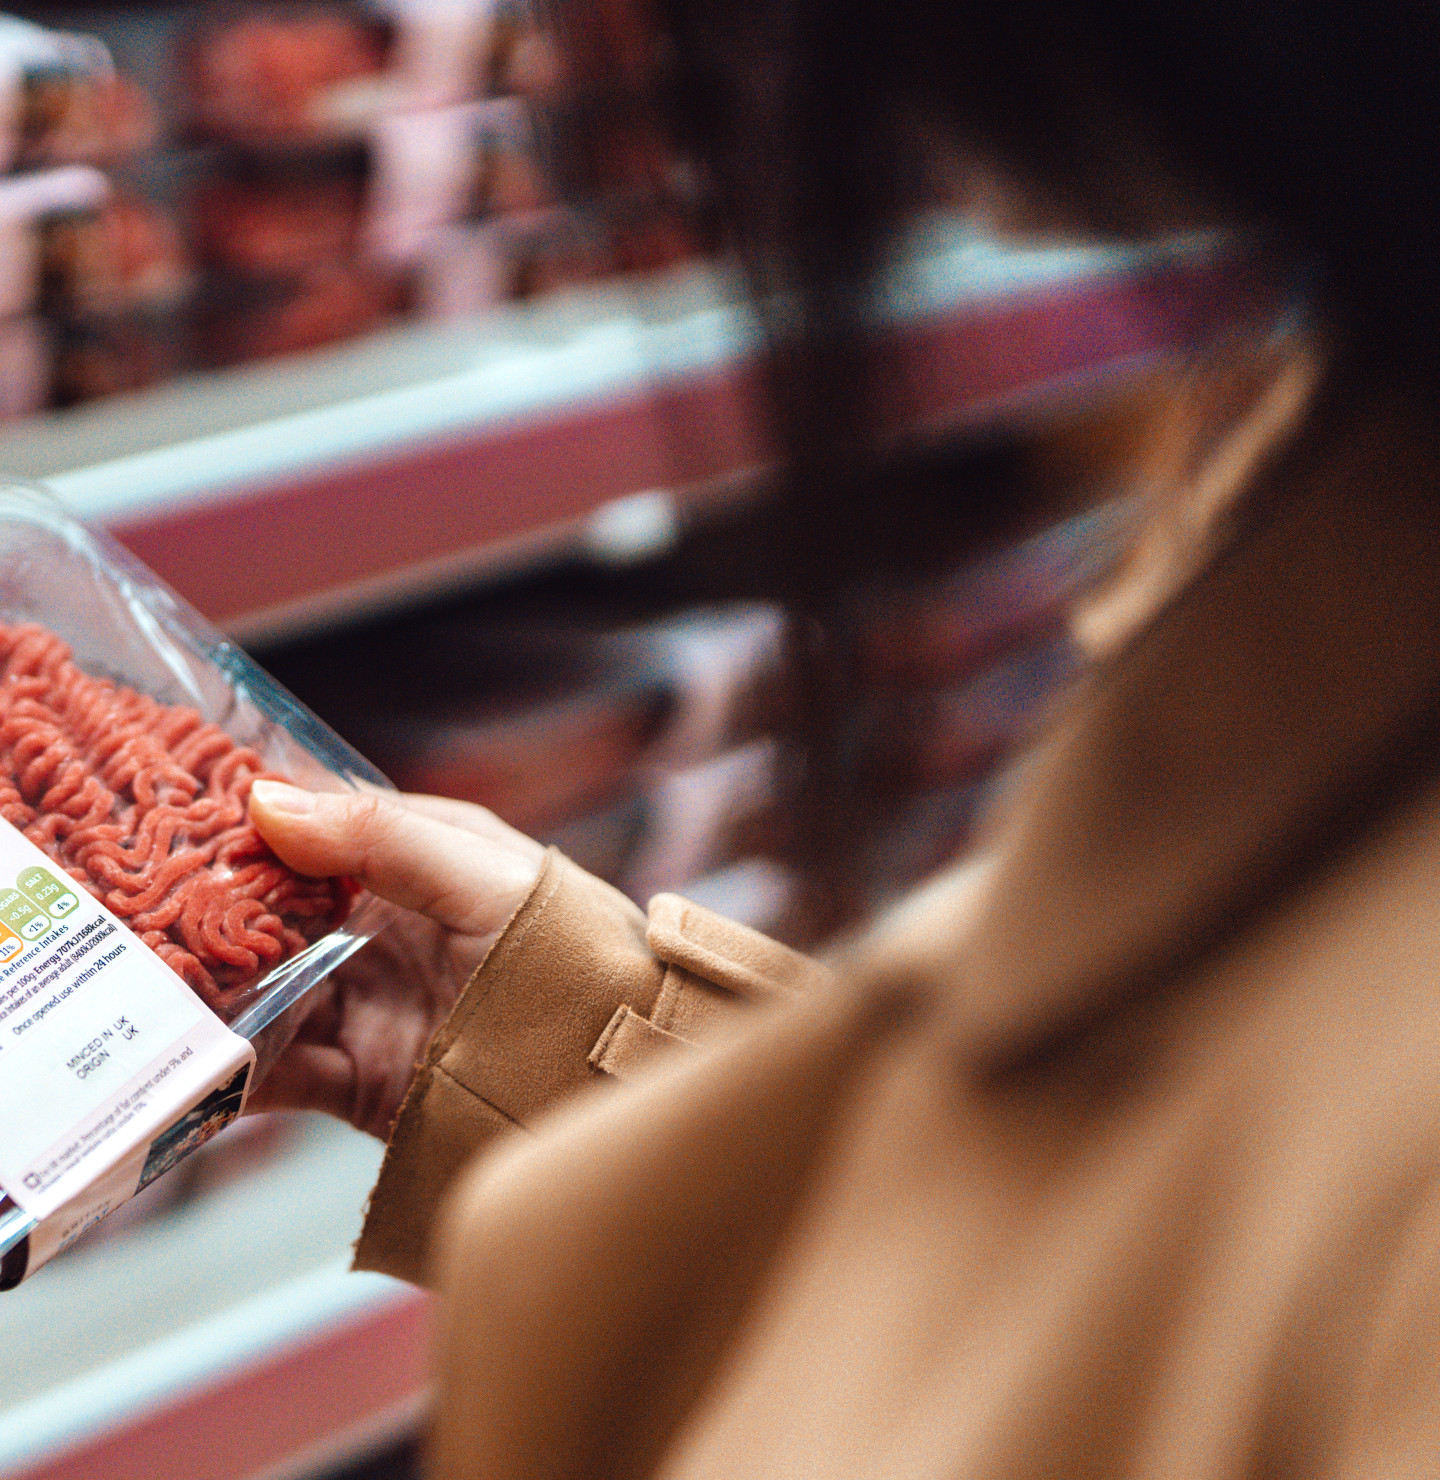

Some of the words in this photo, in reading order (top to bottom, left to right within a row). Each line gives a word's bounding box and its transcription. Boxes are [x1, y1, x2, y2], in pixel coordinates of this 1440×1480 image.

[25, 873, 42, 888] SALT
[35, 883, 59, 900] 0.23g
[9, 904, 32, 921] <0.5g
[57, 902, 70, 910] 4%
[29, 922, 44, 932] <1%
[0, 944, 15, 956] 11%
[2, 947, 41, 977] Reference
[38, 925, 69, 949] Intakes
[6, 985, 19, 998] per
[33, 953, 61, 974] Energy
[56, 915, 106, 956] 707kJ/168kcal
[12, 1018, 34, 1035] Once
[32, 995, 61, 1021] opened
[58, 987, 74, 1000] use
[71, 967, 98, 988] within
[93, 959, 107, 971] 24
[101, 944, 127, 963] hours
[31, 985, 40, 994] an
[38, 970, 60, 988] average
[57, 958, 74, 973] adult
[66, 1038, 103, 1069] MINCED
[101, 1029, 113, 1040] IN
[113, 1016, 129, 1030] UK
[76, 1049, 110, 1079] ORIGIN
[122, 1025, 139, 1040] UK
[152, 1065, 171, 1084] under
[179, 1046, 194, 1061] and
